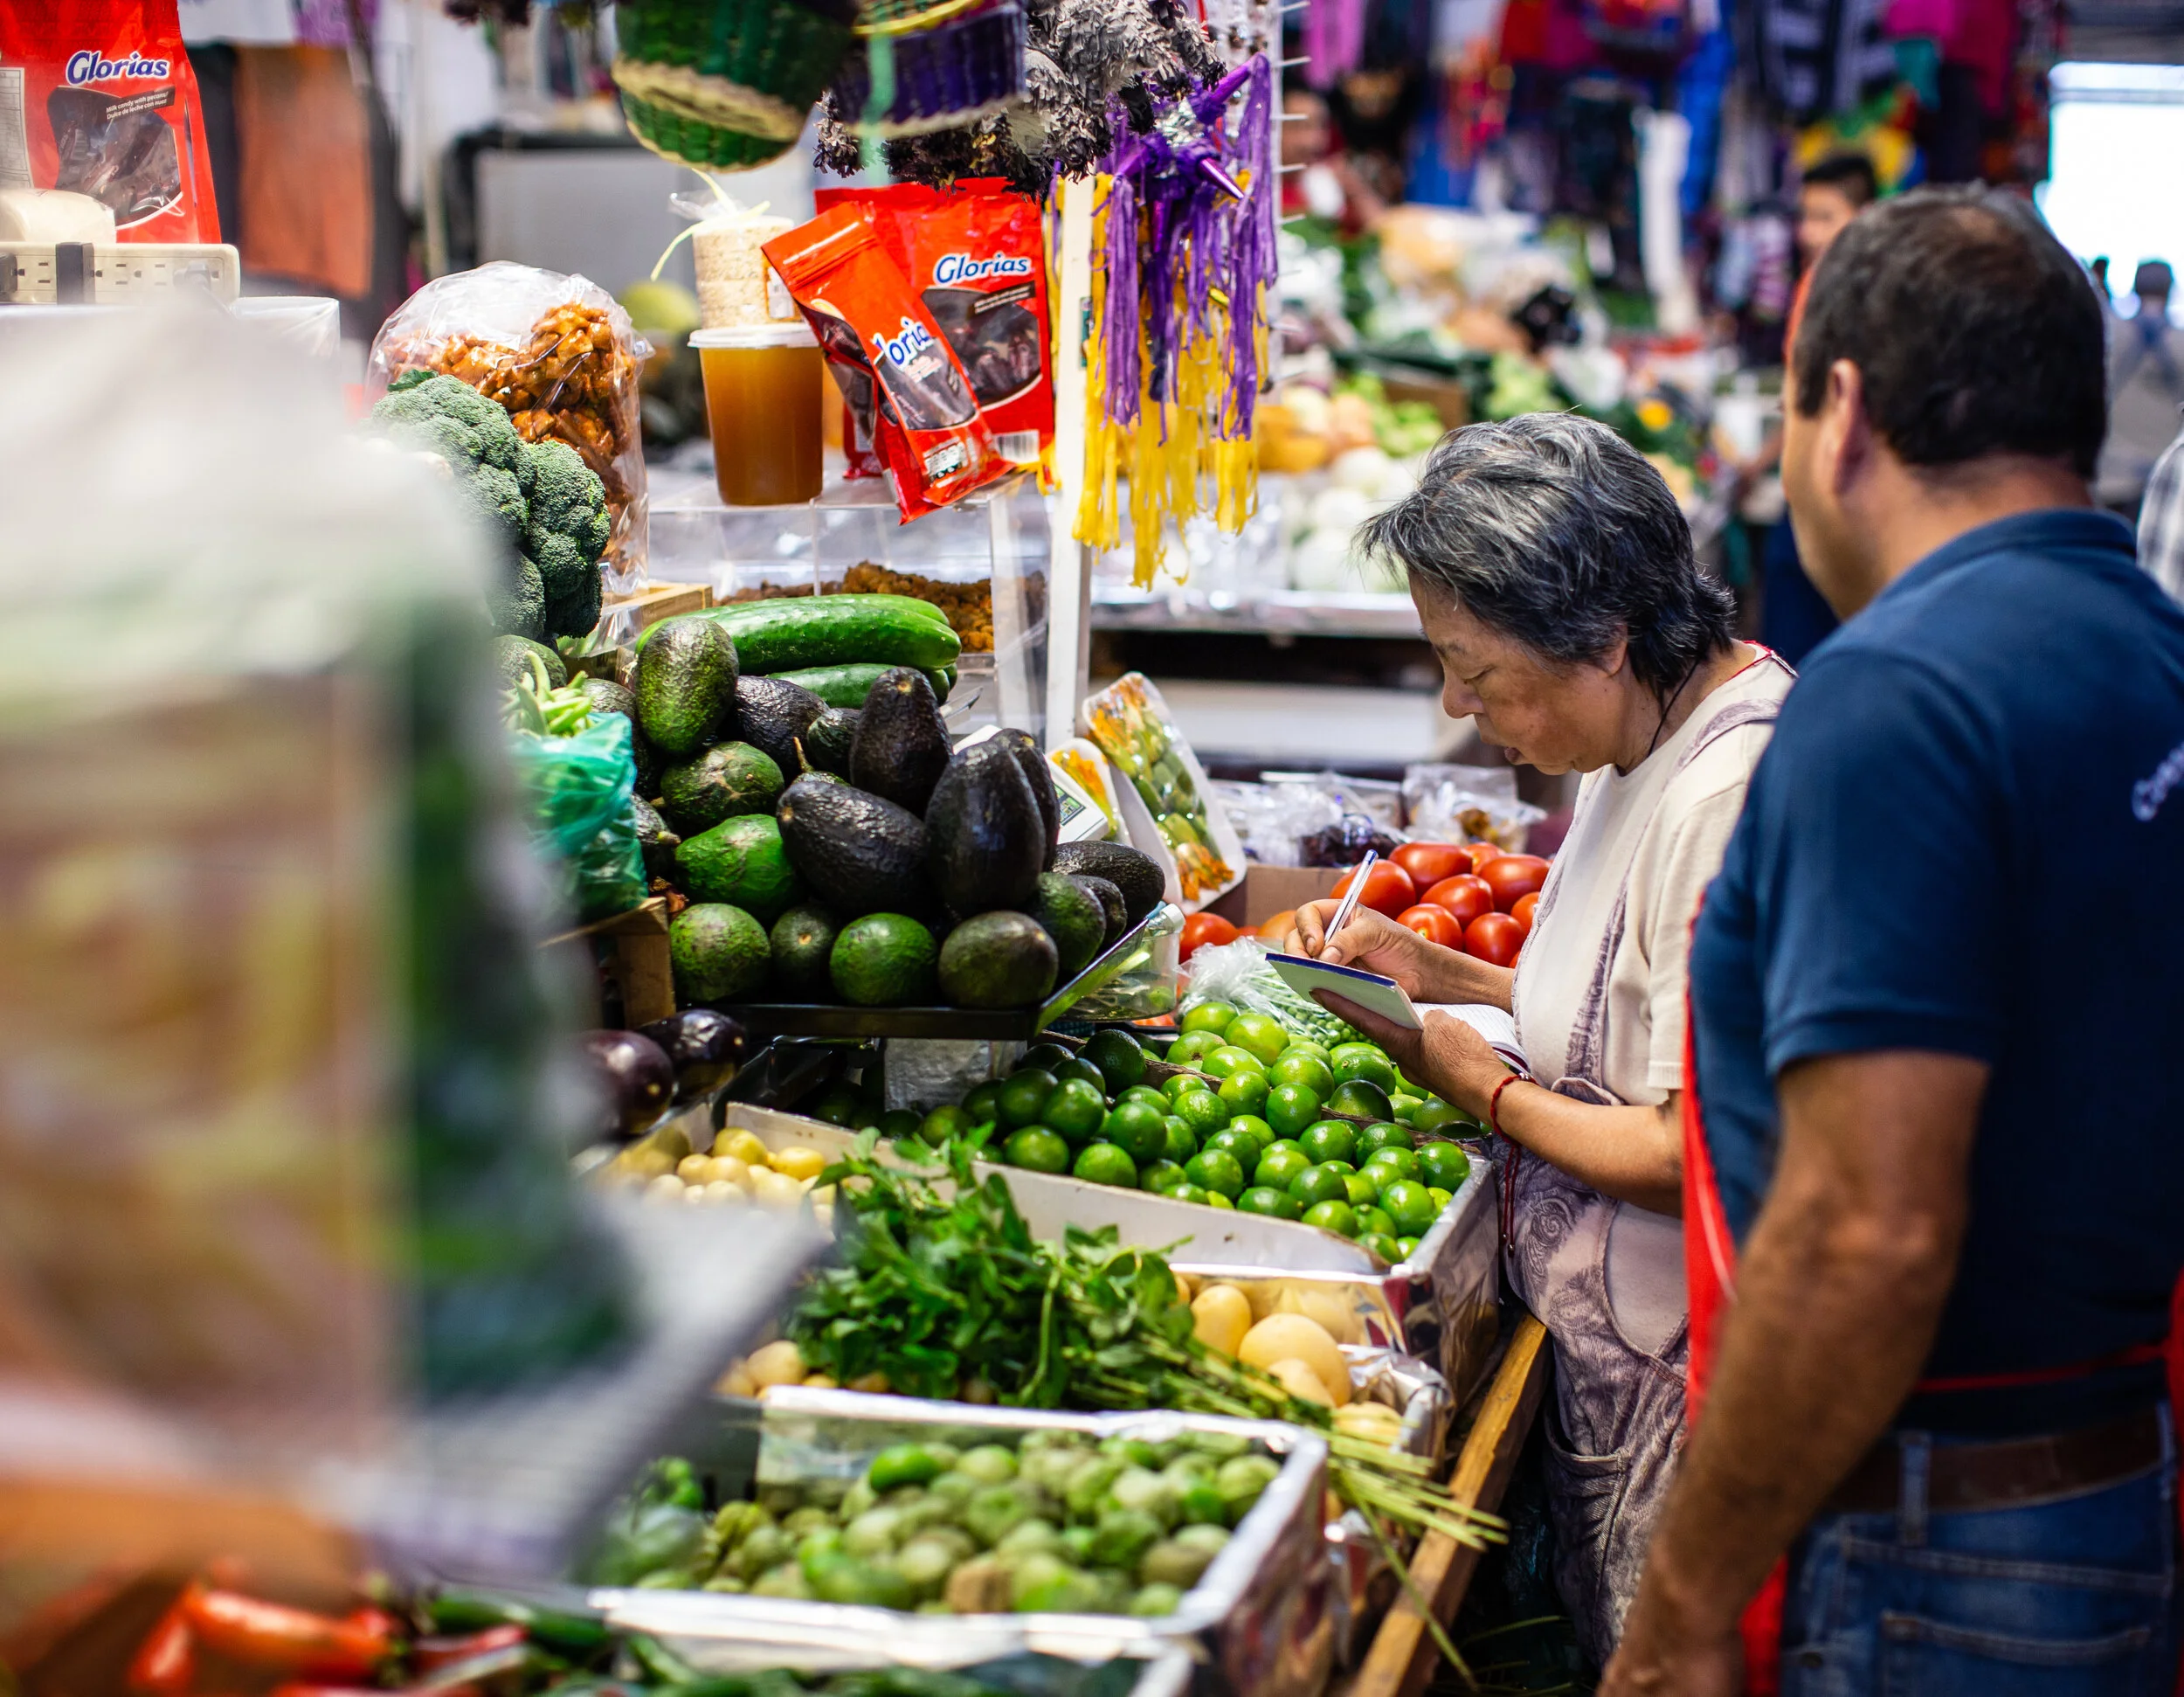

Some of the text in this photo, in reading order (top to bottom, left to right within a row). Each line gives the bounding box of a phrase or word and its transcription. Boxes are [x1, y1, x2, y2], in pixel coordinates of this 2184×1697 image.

[66, 50, 169, 86] Glorias
[117, 100, 134, 109] candy
[134, 96, 147, 105] with
[107, 111, 121, 120] Dulce
[934, 251, 1031, 286] Glorias
